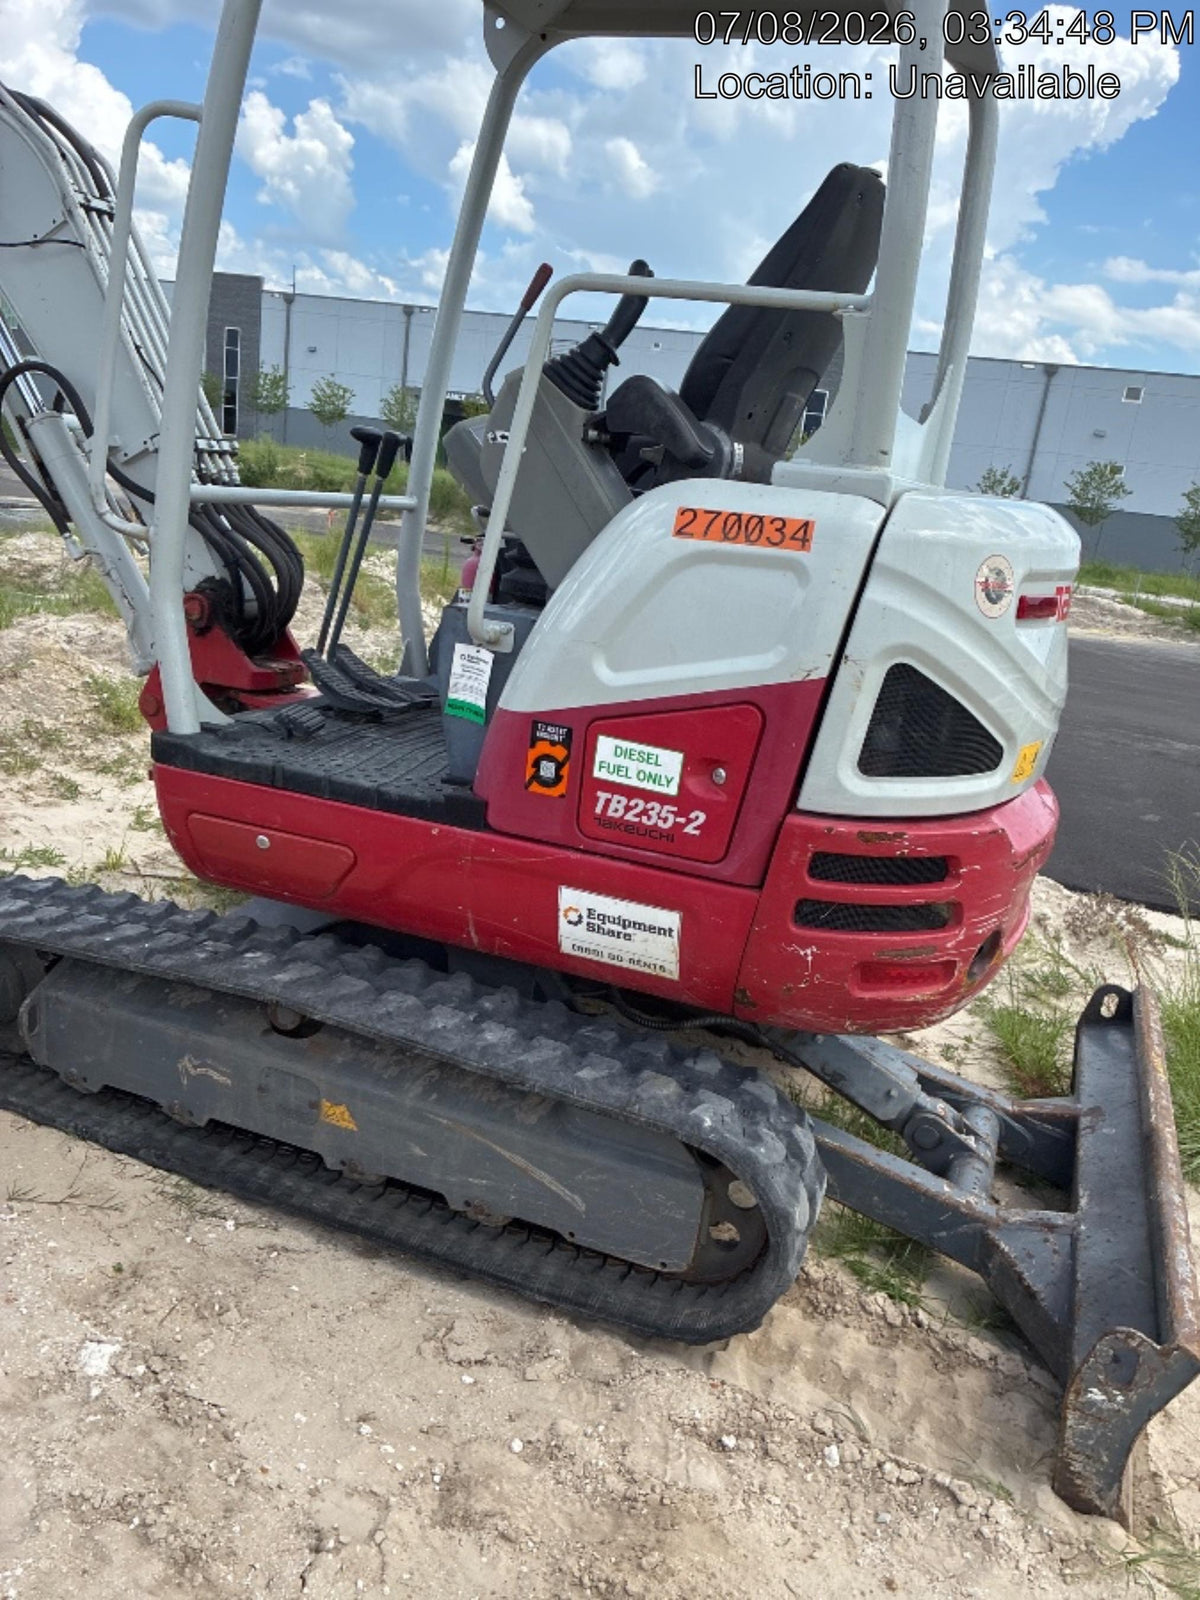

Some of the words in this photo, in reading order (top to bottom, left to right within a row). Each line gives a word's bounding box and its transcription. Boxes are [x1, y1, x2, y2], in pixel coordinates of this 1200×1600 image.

[675, 508, 811, 549] 270034
[614, 745, 662, 767] DIESEL
[598, 761, 632, 780] FUEL
[636, 769, 674, 788] ONLY
[594, 791, 707, 836] TB235-2
[586, 908, 675, 939] Equipment
